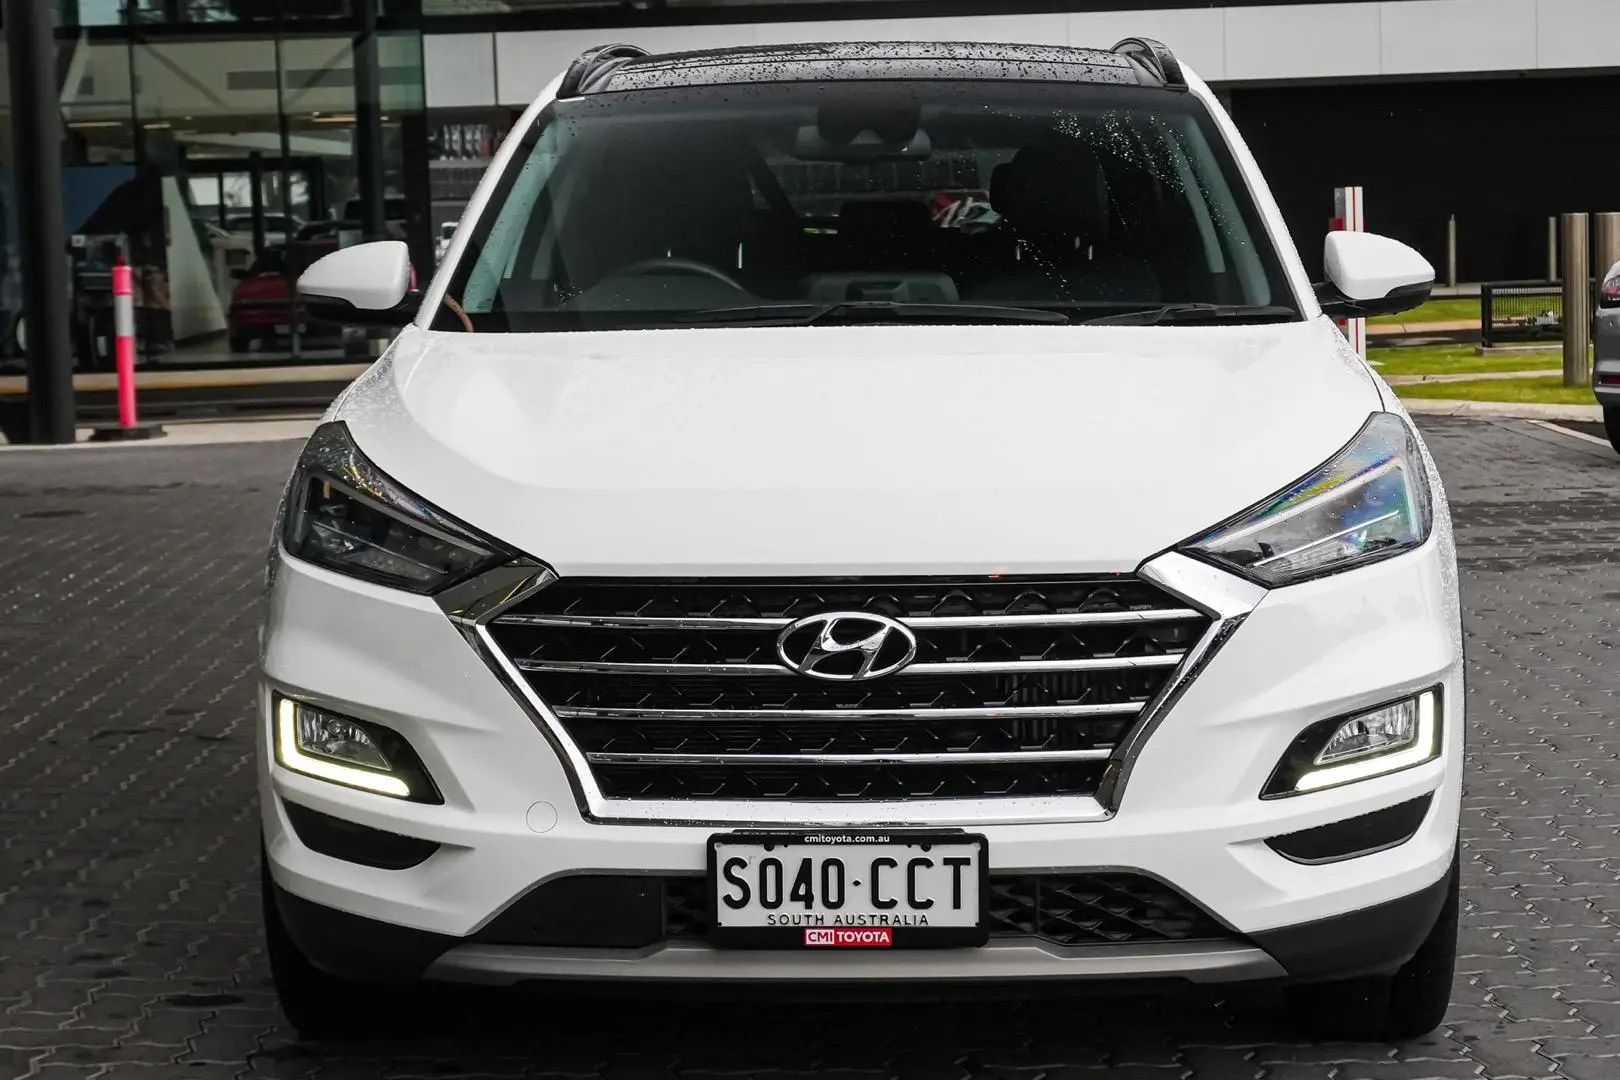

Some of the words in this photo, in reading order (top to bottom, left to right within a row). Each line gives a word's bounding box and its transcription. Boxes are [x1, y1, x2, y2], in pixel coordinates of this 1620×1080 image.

[804, 833, 890, 845] cmitoyota.com.au
[767, 914, 825, 925] SOUTH
[833, 914, 929, 925] AUSTRALIA
[807, 931, 833, 943] CMI
[836, 931, 890, 943] TOYOTA
